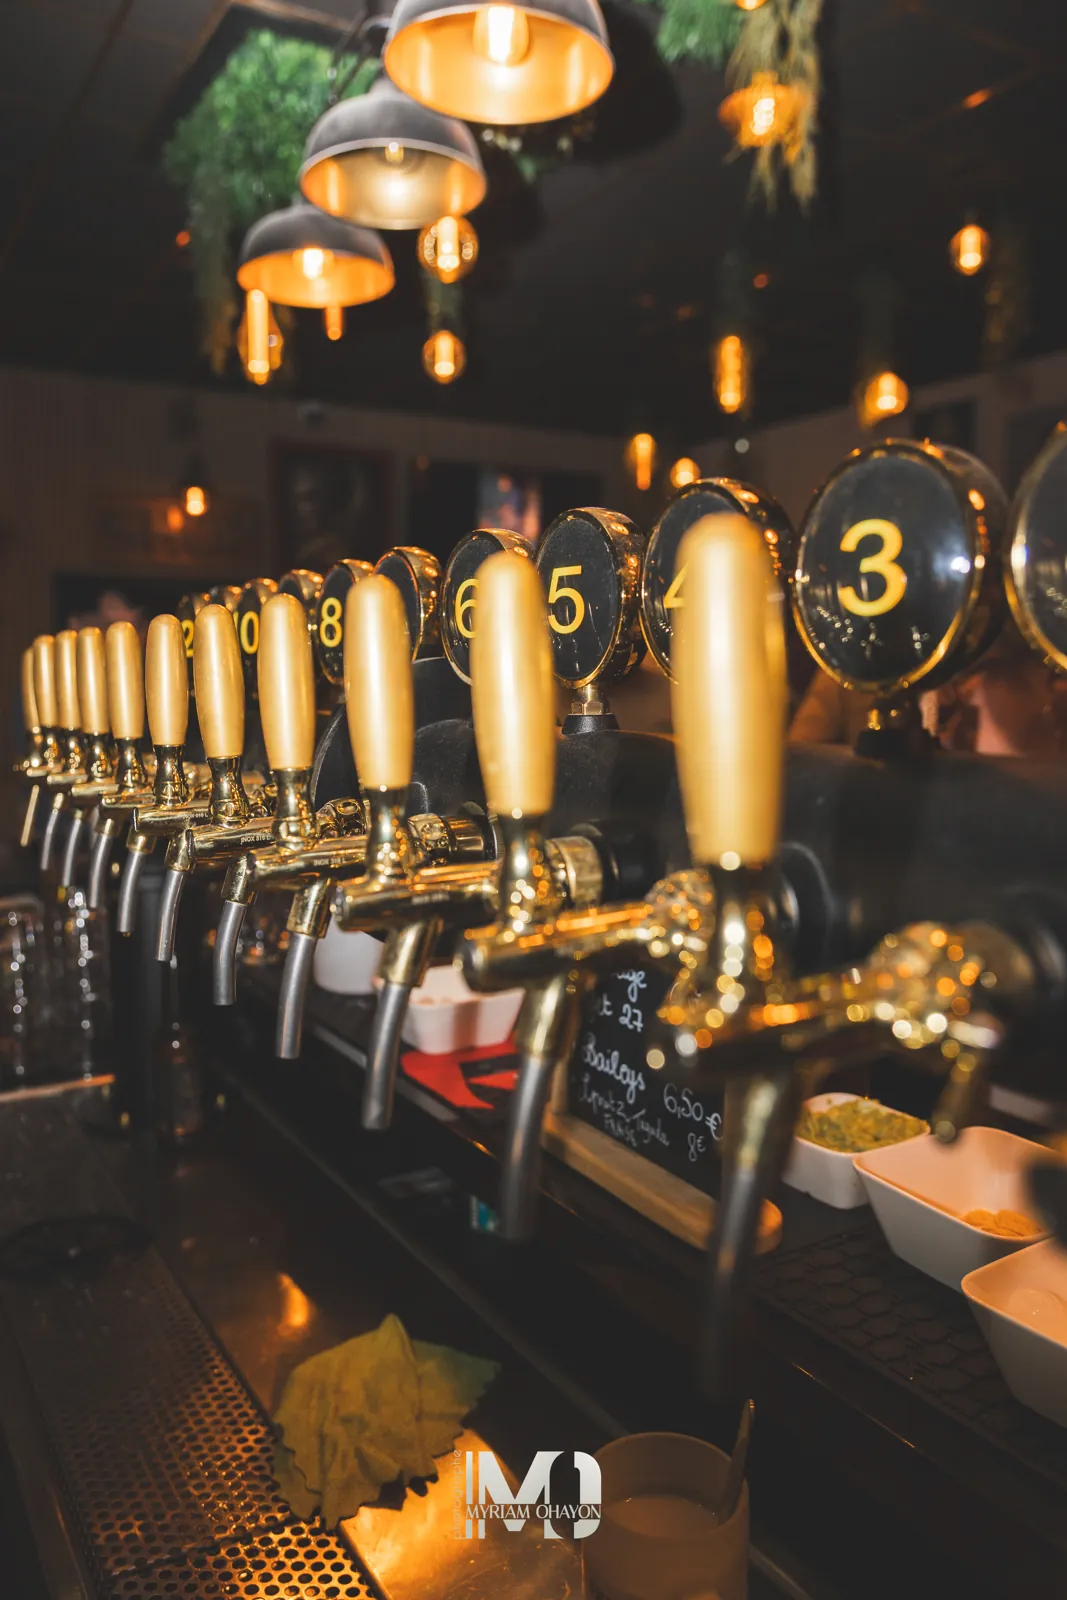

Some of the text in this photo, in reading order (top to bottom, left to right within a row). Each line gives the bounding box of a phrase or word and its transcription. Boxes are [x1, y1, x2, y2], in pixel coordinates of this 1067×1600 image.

[838, 518, 907, 617] 3
[319, 597, 342, 648] 8
[548, 565, 585, 635] 5
[618, 1003, 645, 1033] 27
